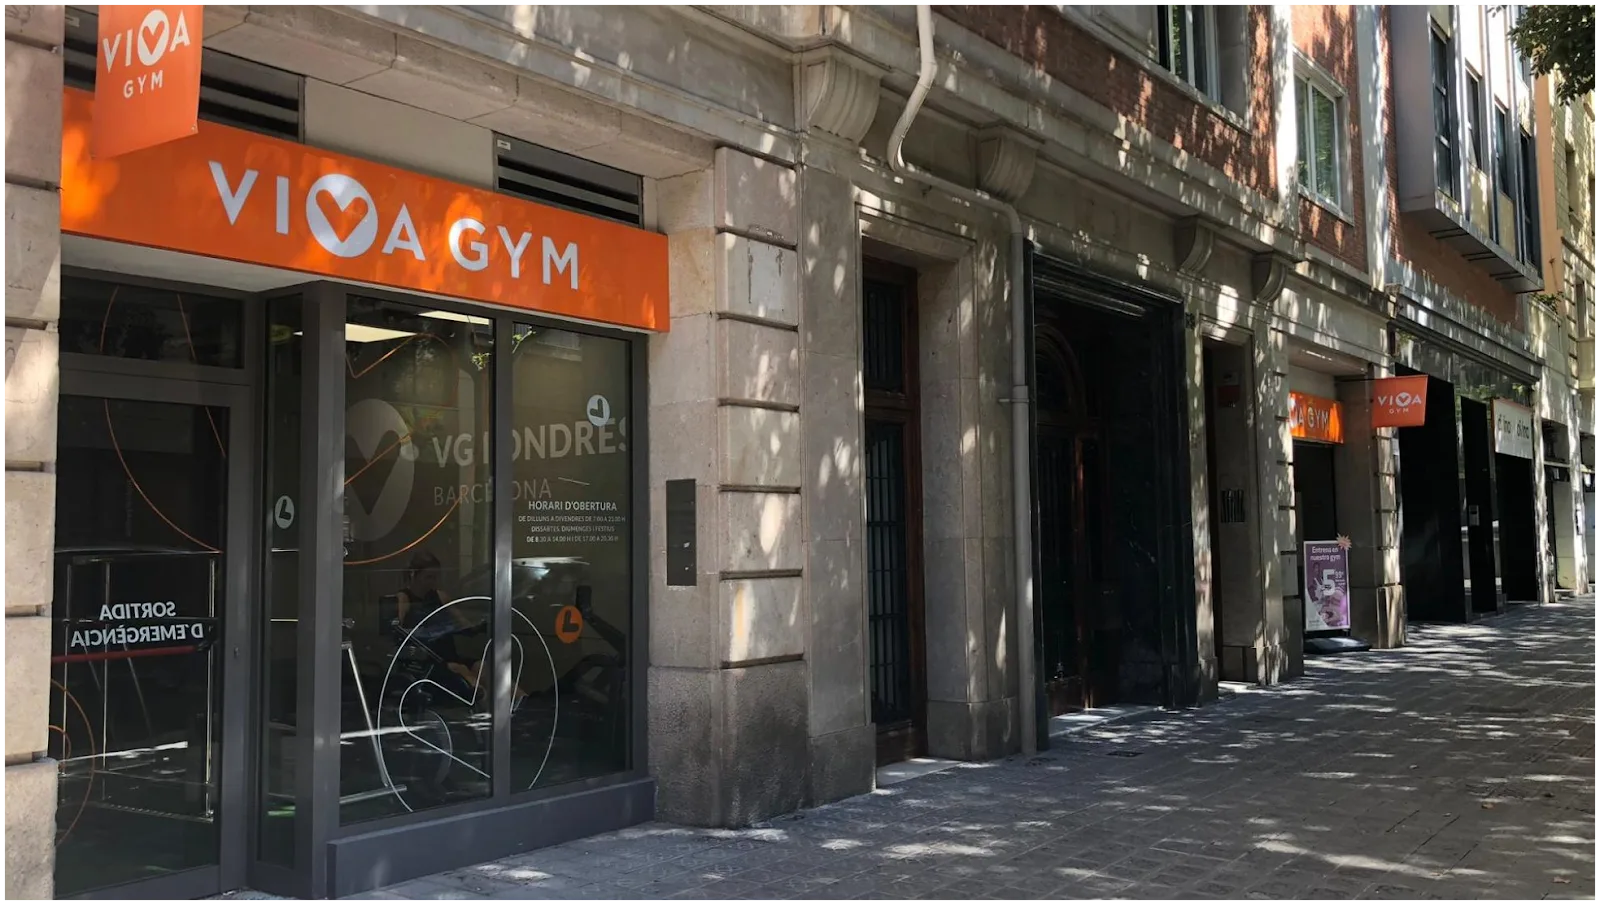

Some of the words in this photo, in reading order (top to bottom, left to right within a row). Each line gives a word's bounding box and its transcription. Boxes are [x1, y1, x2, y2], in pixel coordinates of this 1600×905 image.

[102, 9, 191, 73] VIVA
[123, 70, 163, 98] GYM
[208, 160, 425, 261] VIVA
[447, 218, 578, 290] GYM
[1308, 406, 1329, 437] GYM
[1388, 407, 1409, 415] GYM
[432, 433, 474, 468] VG
[434, 477, 552, 506] BARCEONA
[528, 501, 563, 510] HORARI
[565, 501, 617, 511] D'OBERTURA
[526, 535, 535, 543] DE
[1329, 554, 1341, 562] gym
[1323, 568, 1336, 596] 5
